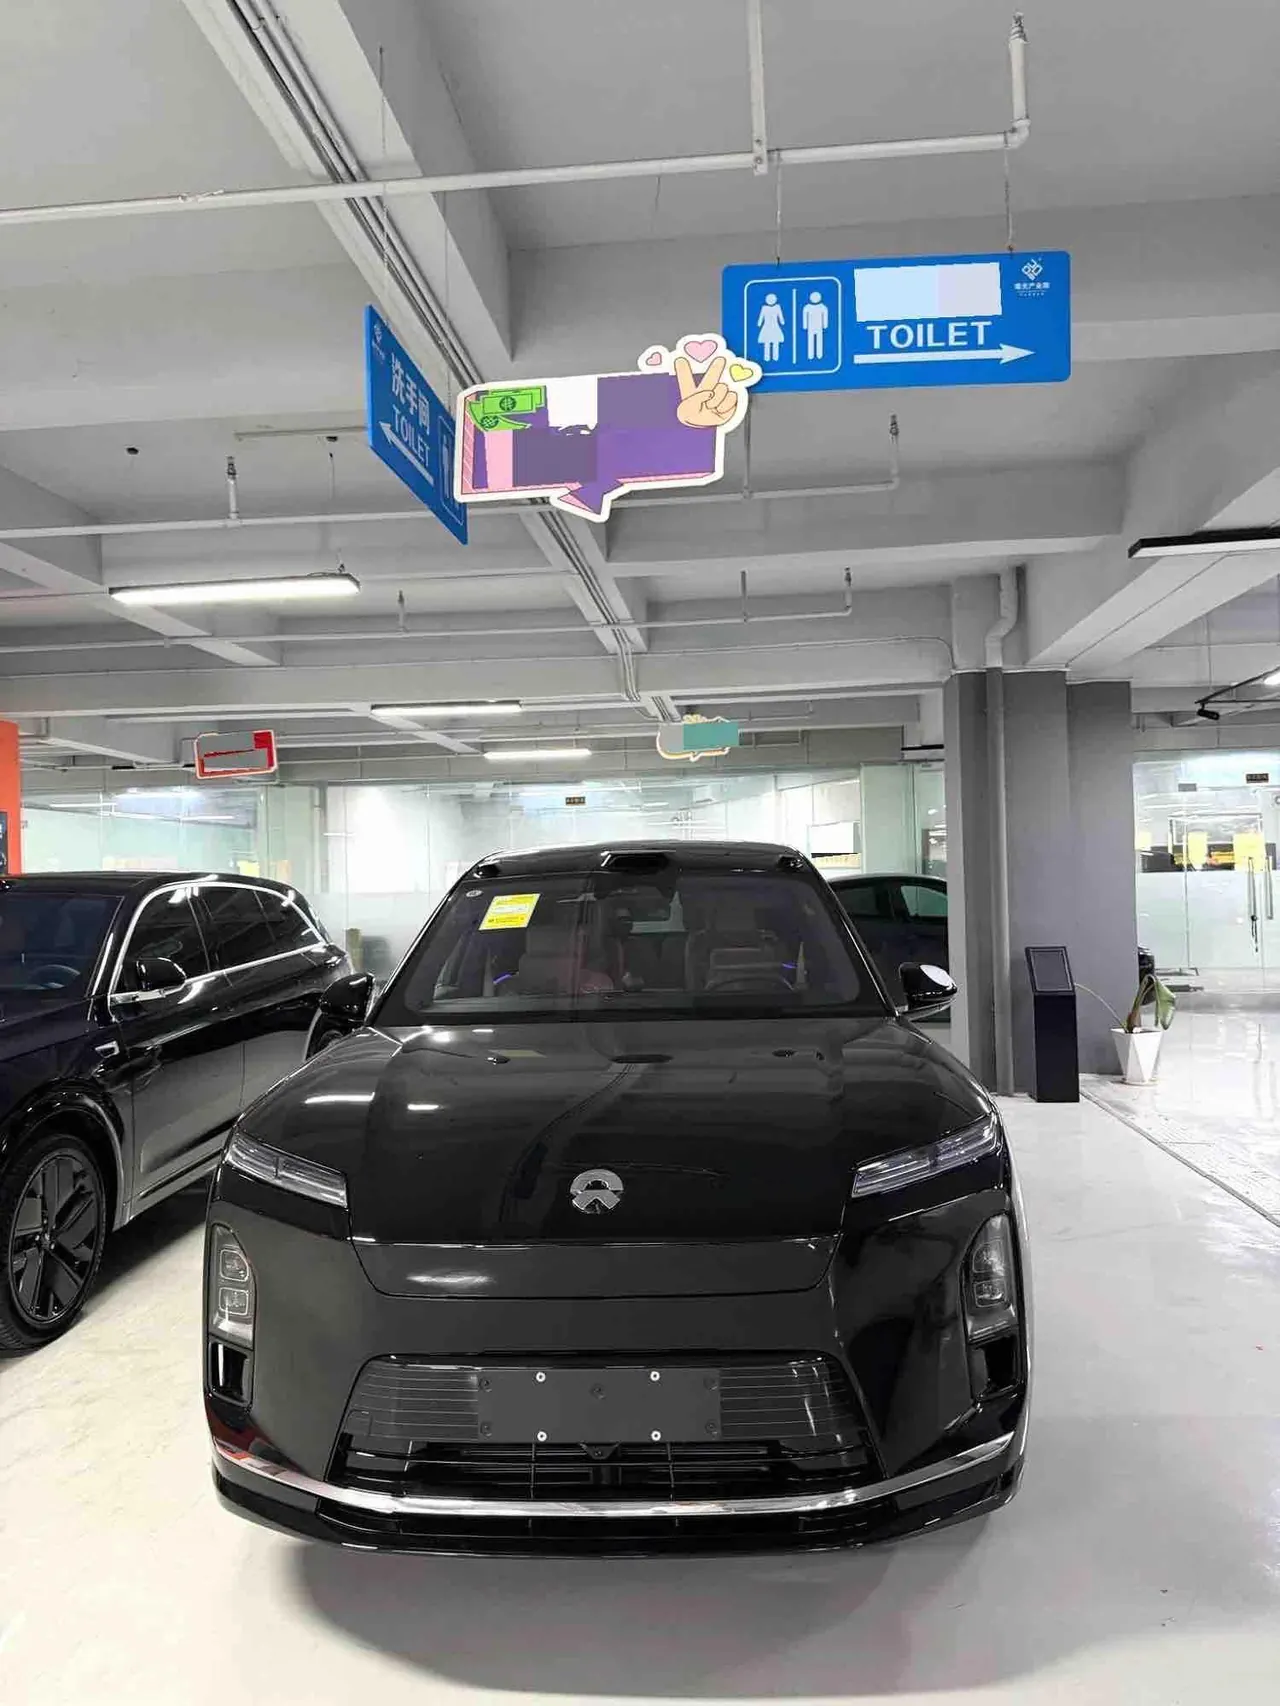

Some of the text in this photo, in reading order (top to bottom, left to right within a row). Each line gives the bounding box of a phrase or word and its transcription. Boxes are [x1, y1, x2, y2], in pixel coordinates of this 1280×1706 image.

[867, 321, 992, 349] TOILET
[391, 353, 430, 435] 洗手间
[393, 405, 430, 467] TOILET
